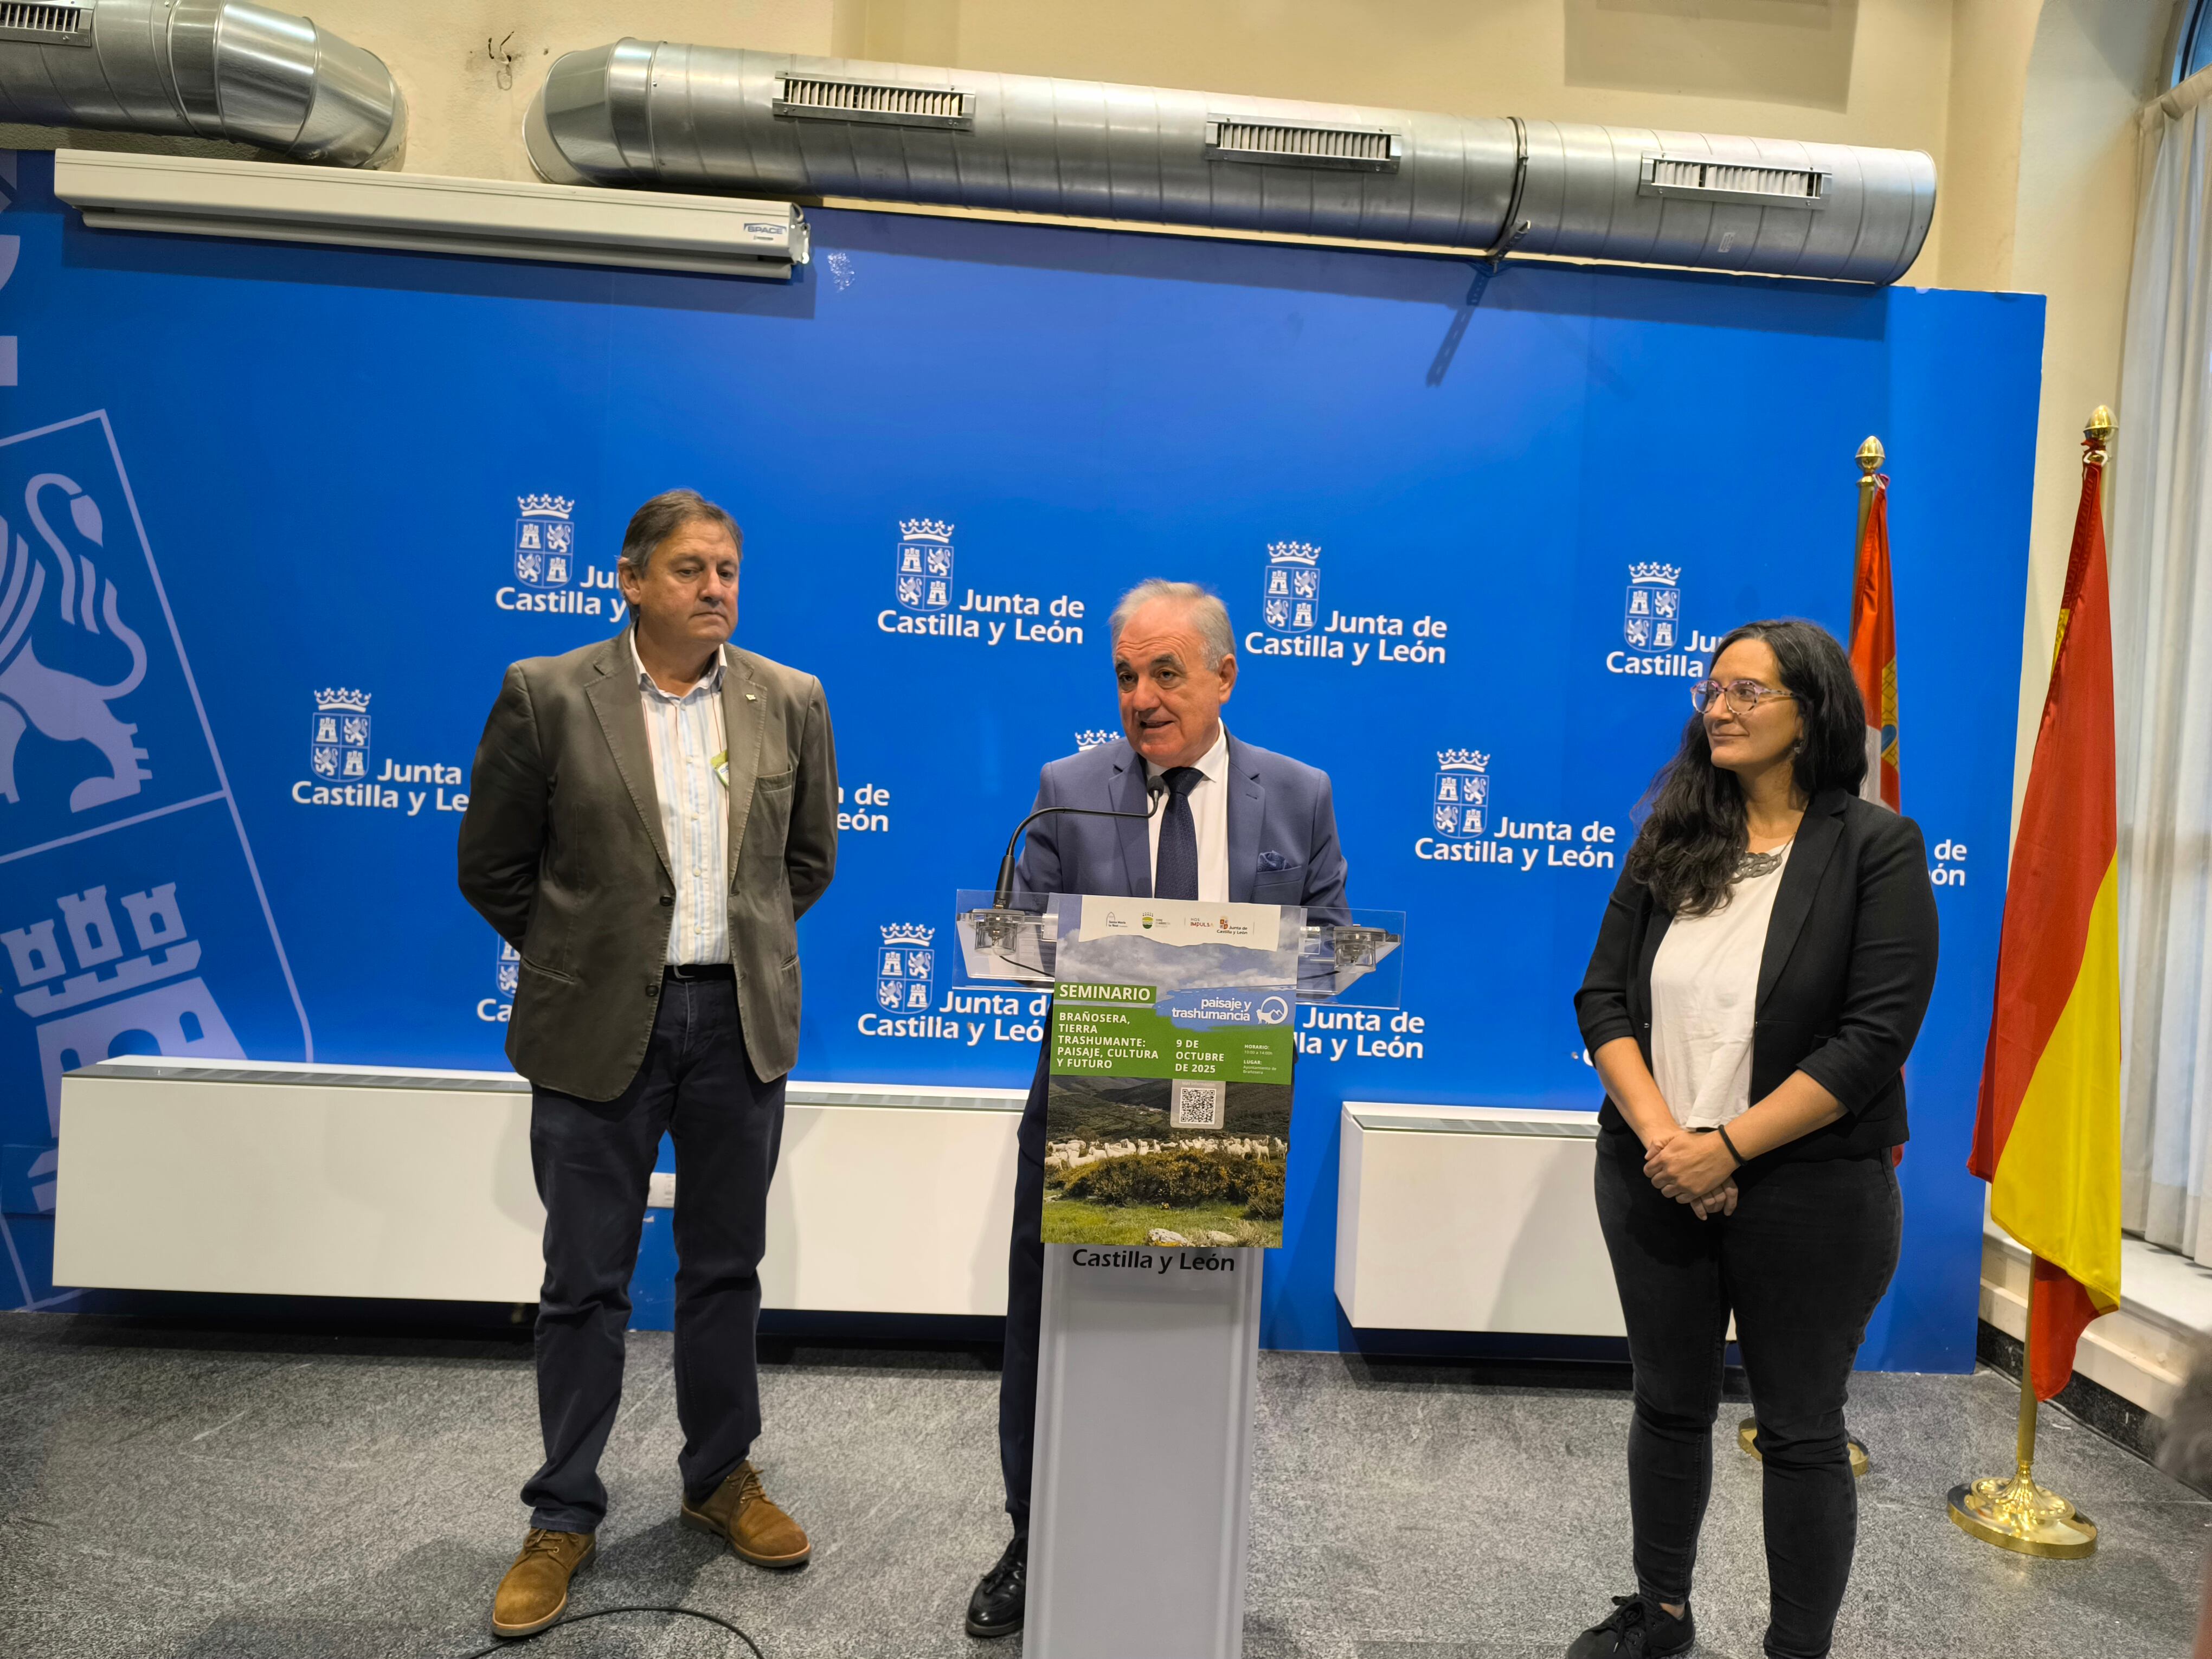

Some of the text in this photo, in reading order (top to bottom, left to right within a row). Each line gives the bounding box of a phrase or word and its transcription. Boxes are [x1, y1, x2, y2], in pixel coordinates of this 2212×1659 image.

[748, 226, 783, 234] SPACE
[496, 587, 627, 623] Castilla y
[959, 589, 1085, 618] Junta de
[878, 610, 1084, 646] Castilla y León
[1324, 610, 1448, 638] Junta de
[1245, 632, 1446, 666] Castilla y León
[1606, 651, 1703, 678] Castilla
[377, 758, 461, 785] Junta
[292, 781, 470, 816] Castilla y Le
[854, 783, 890, 806] de
[837, 808, 889, 832] eón
[1494, 817, 1616, 843] Junta de
[1414, 837, 1614, 871] Castilla y León
[1934, 839, 1967, 861] de
[1928, 863, 1965, 886] ón
[938, 991, 1049, 1017] Junta d
[1059, 984, 1150, 1001] SEMINARIO
[1201, 996, 1252, 1012] paisaje y
[1059, 1011, 1130, 1025] BRAÑOSERA,
[1172, 1007, 1250, 1021] trashumancia
[1302, 1007, 1425, 1034] Junta de
[857, 1013, 1044, 1046] Castilla y Leó
[1058, 1024, 1098, 1034] TIERRA
[1058, 1035, 1146, 1047] TRASHUMANTE:
[1057, 1047, 1159, 1059] PAISAJE, CULTURA
[1176, 1039, 1199, 1049] 9 DE
[1330, 1038, 1348, 1062] y
[1356, 1034, 1424, 1059] León
[1057, 1058, 1113, 1069] Y FUTURO
[1175, 1051, 1225, 1062] OCTUBRE
[1175, 1063, 1216, 1073] DE 2025
[1072, 1249, 1235, 1274] Castilla y León
